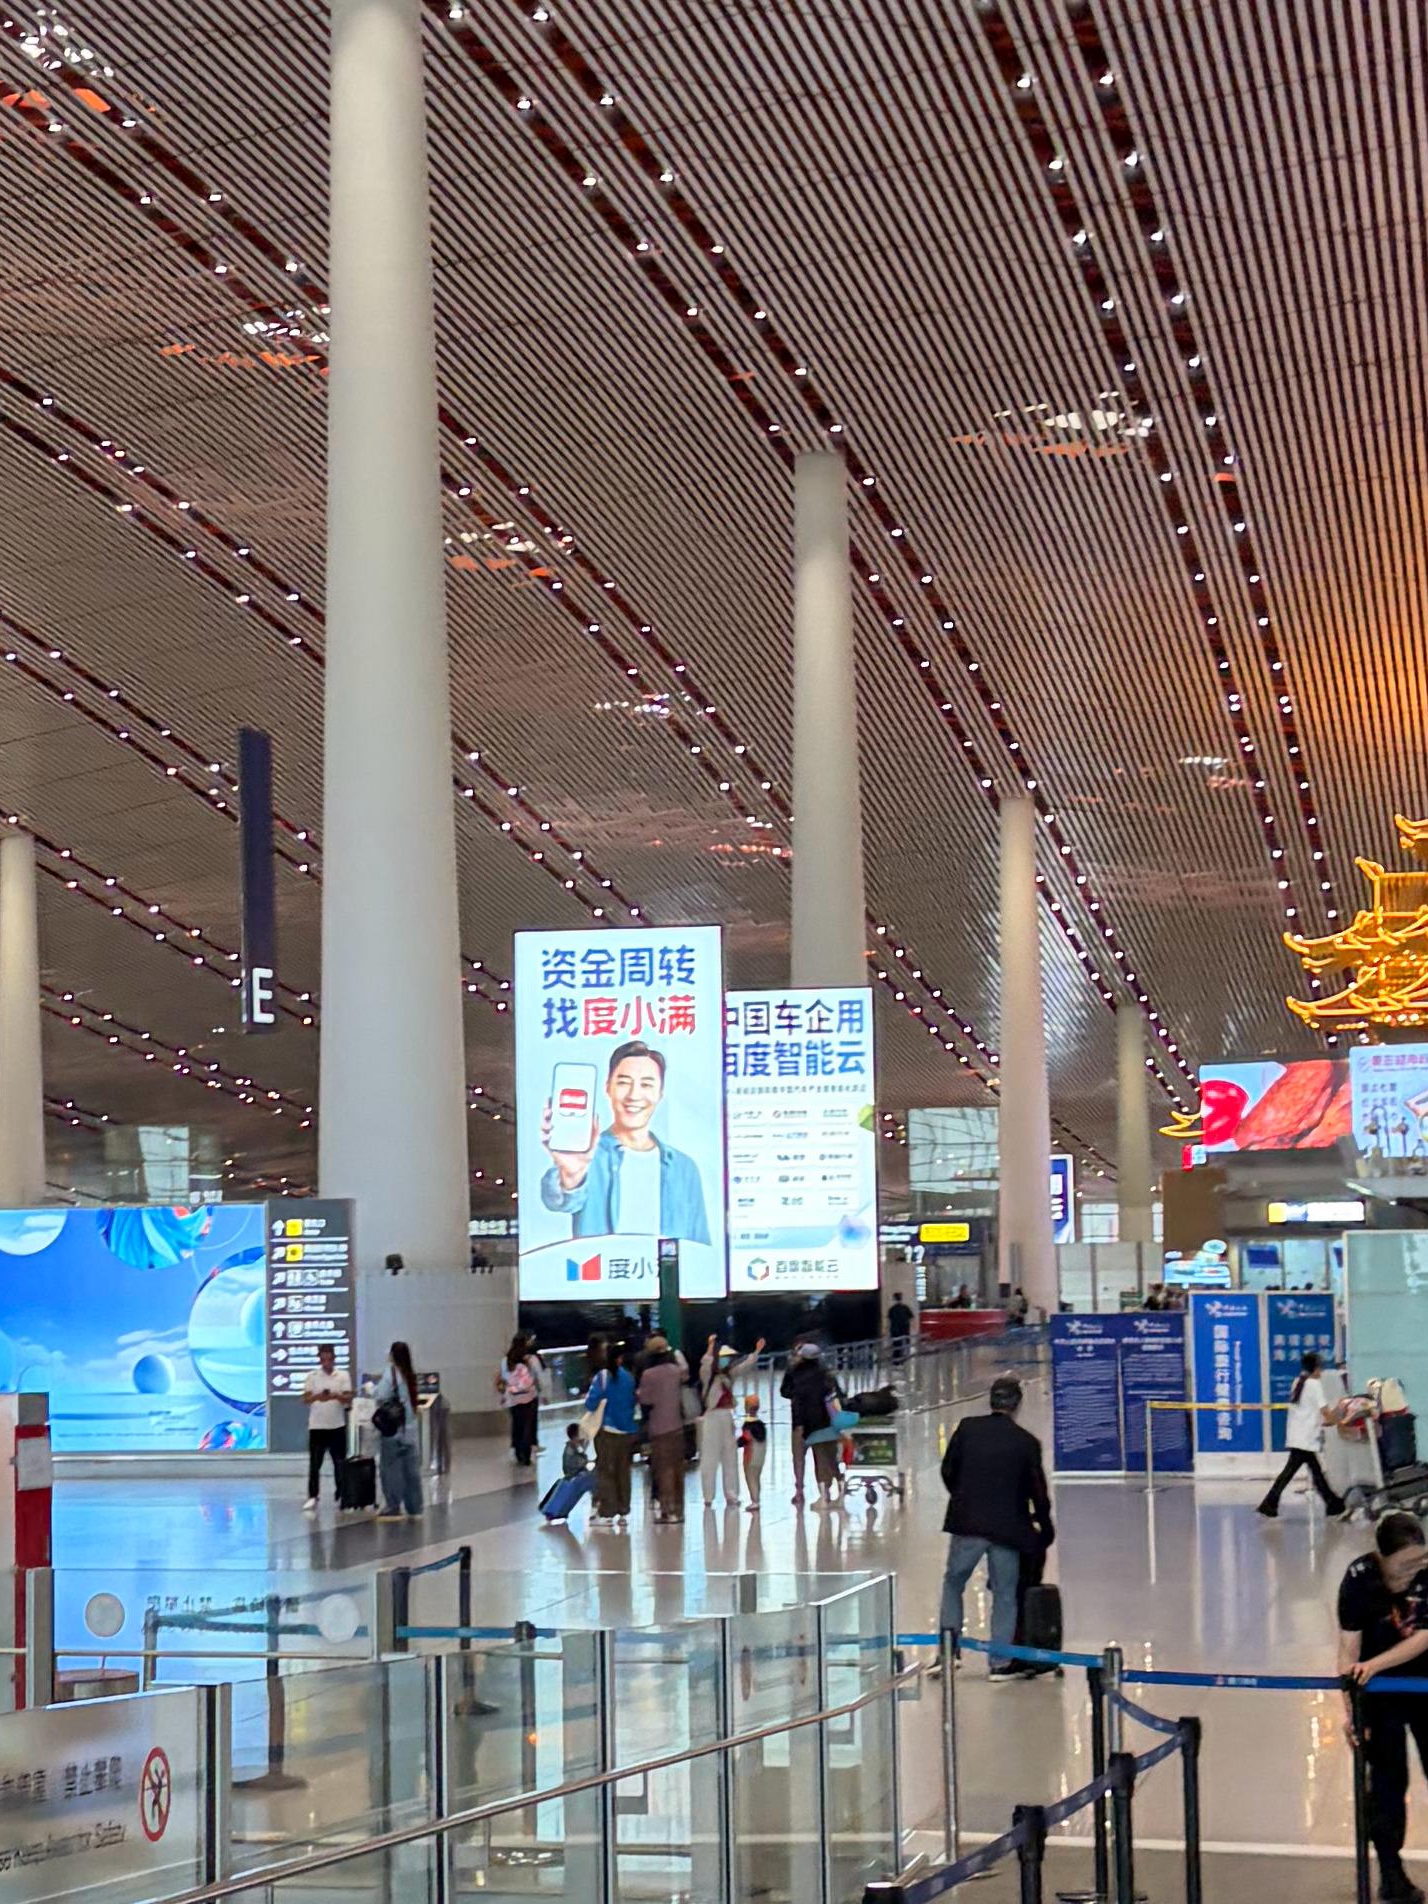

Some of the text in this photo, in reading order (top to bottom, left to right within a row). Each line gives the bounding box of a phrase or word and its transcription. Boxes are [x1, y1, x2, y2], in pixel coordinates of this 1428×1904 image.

[542, 945, 696, 989] 资金周转
[252, 968, 275, 1023] E
[542, 995, 697, 1038] 找度小满
[608, 1257, 659, 1279] 度小
